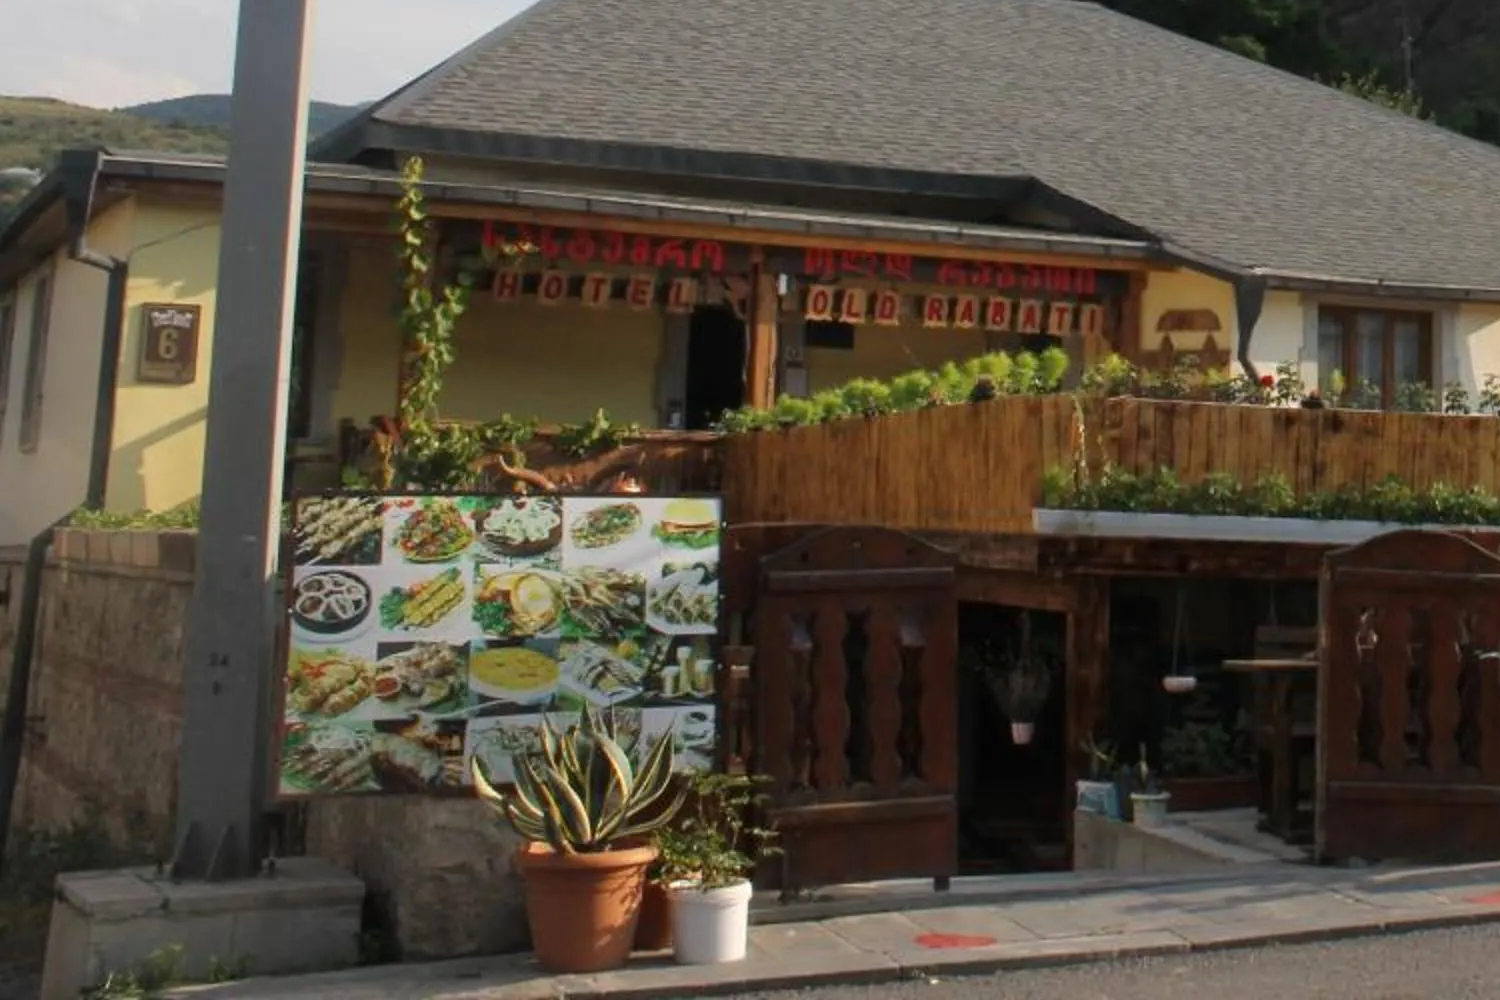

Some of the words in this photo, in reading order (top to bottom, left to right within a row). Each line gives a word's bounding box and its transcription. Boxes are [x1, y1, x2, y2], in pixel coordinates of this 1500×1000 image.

[483, 219, 724, 271] სსტუმრო
[499, 274, 692, 309] HOTEL
[811, 291, 896, 320] OLD
[928, 300, 1096, 332] RABATI
[159, 329, 178, 360] 6
